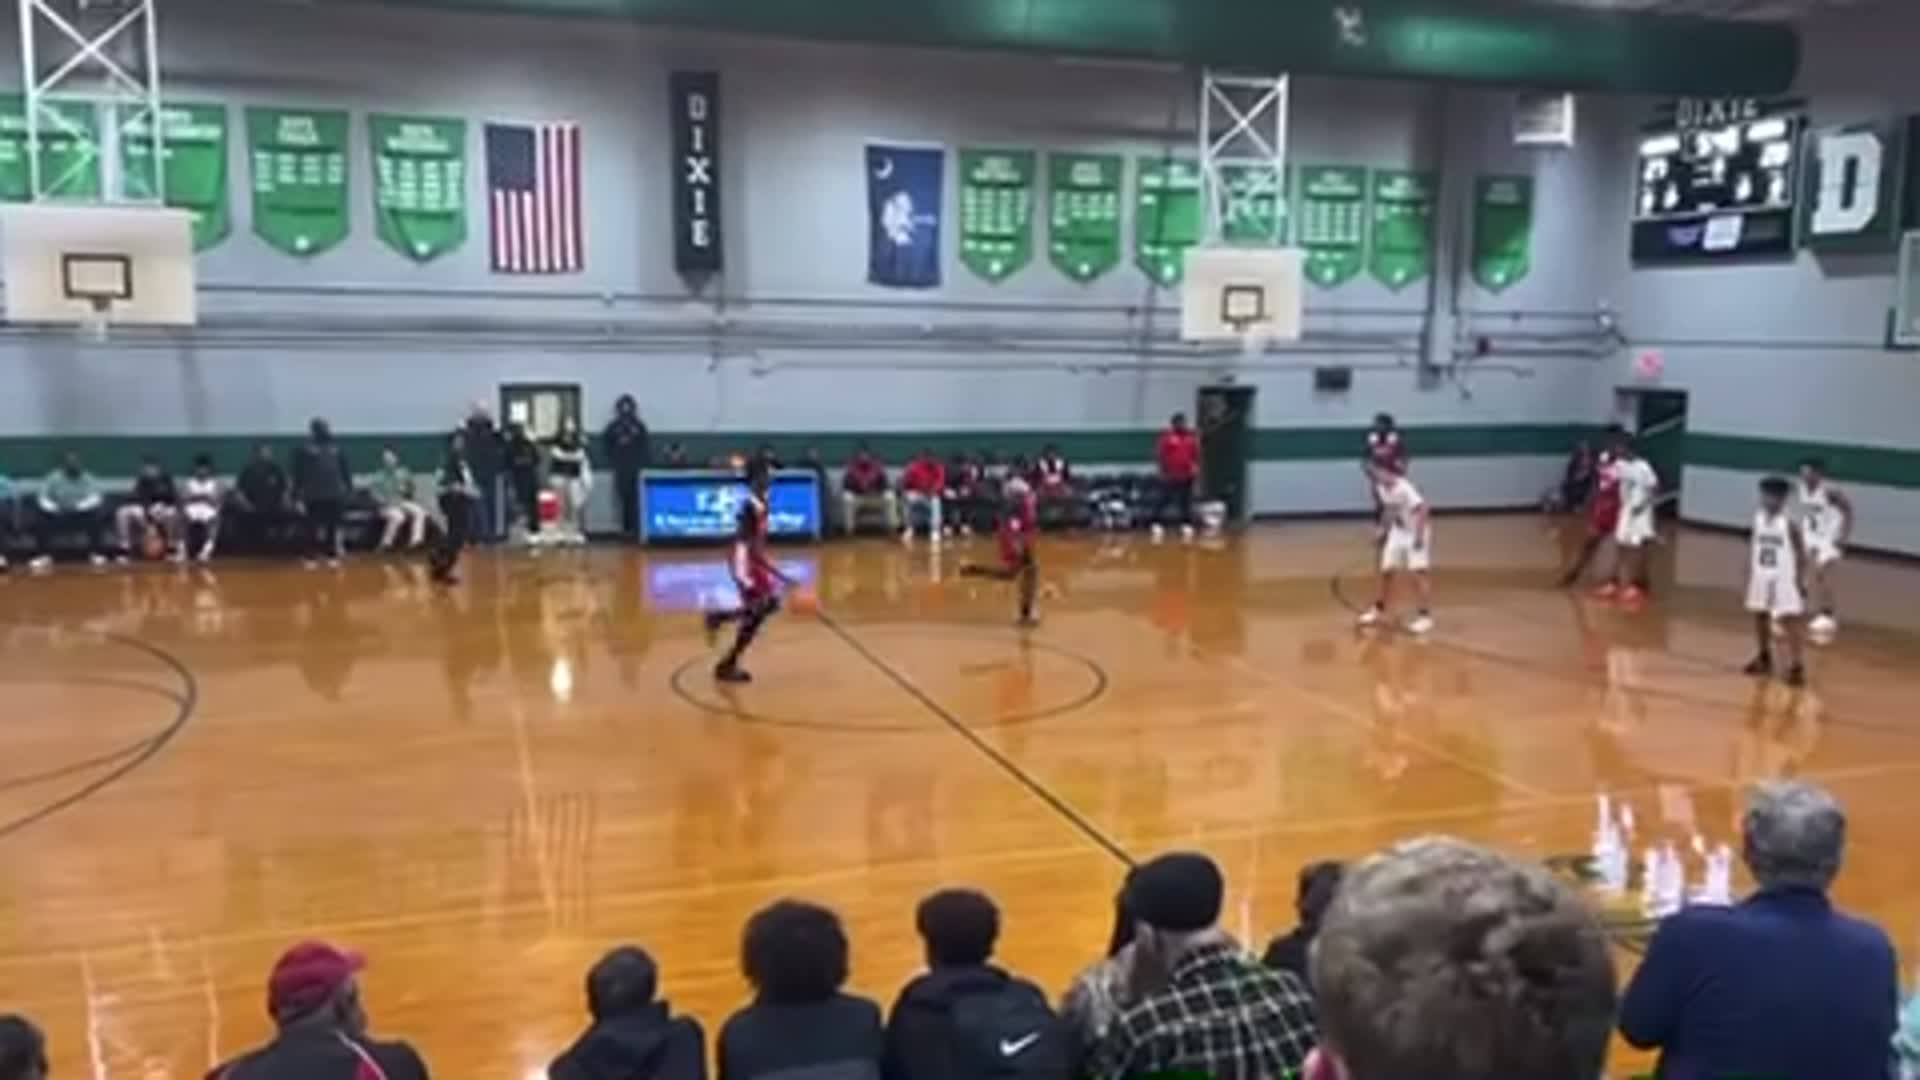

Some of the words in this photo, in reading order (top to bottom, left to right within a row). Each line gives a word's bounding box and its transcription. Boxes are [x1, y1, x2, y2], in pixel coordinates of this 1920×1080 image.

[1676, 98, 1759, 127] DIXIE
[685, 93, 711, 248] DIXIE
[1811, 131, 1882, 234] D
